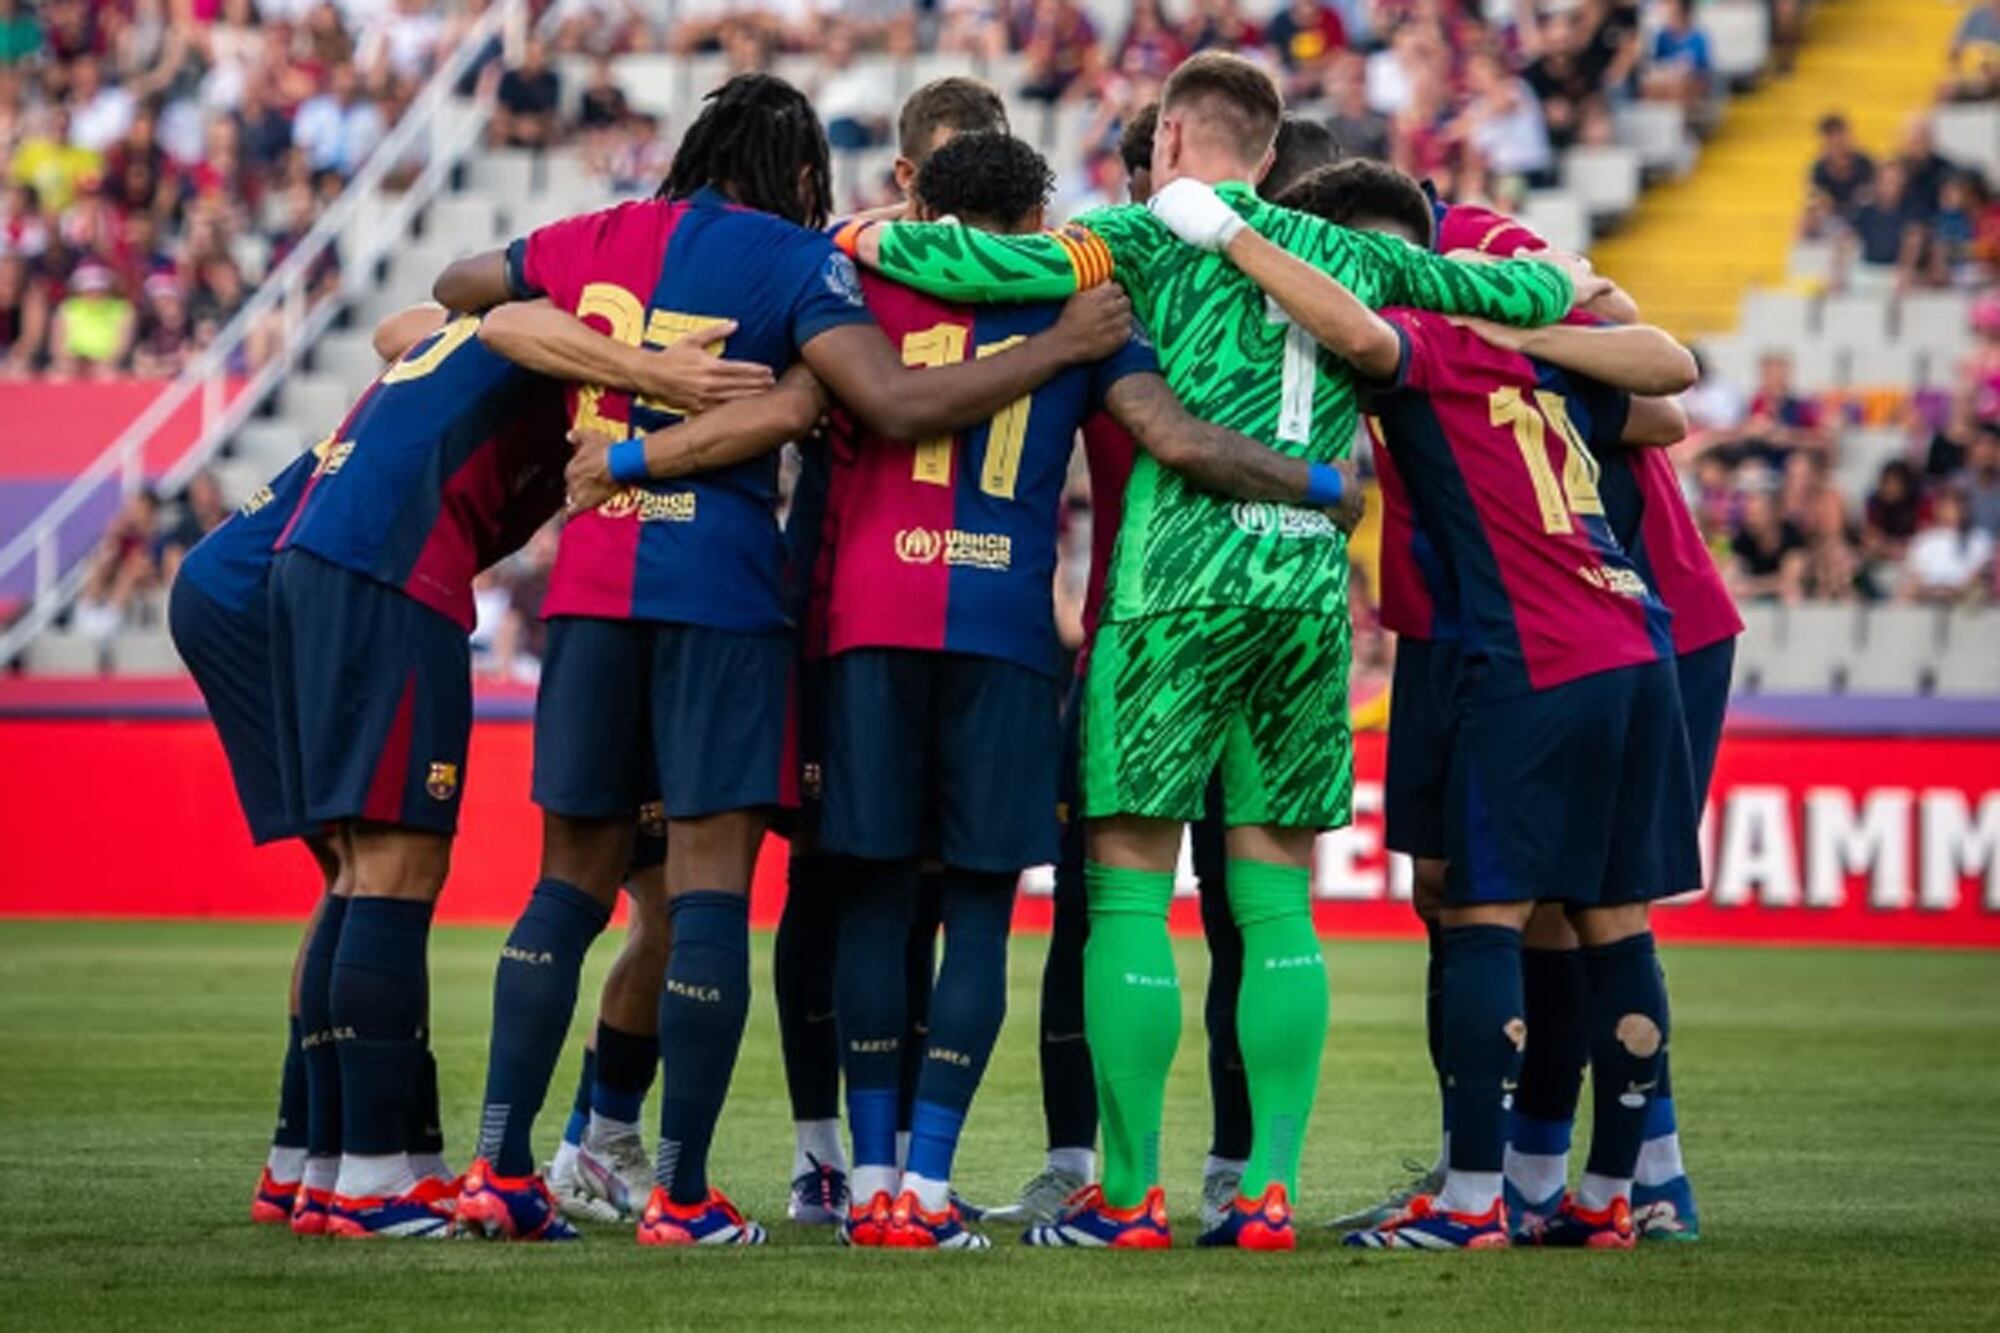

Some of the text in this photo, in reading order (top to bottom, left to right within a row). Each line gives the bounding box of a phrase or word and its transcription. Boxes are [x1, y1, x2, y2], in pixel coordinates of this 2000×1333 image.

[902, 322, 1031, 500] 11
[1264, 294, 1316, 446] 1
[1489, 385, 1605, 535] 14
[1655, 786, 2000, 907] AMM
